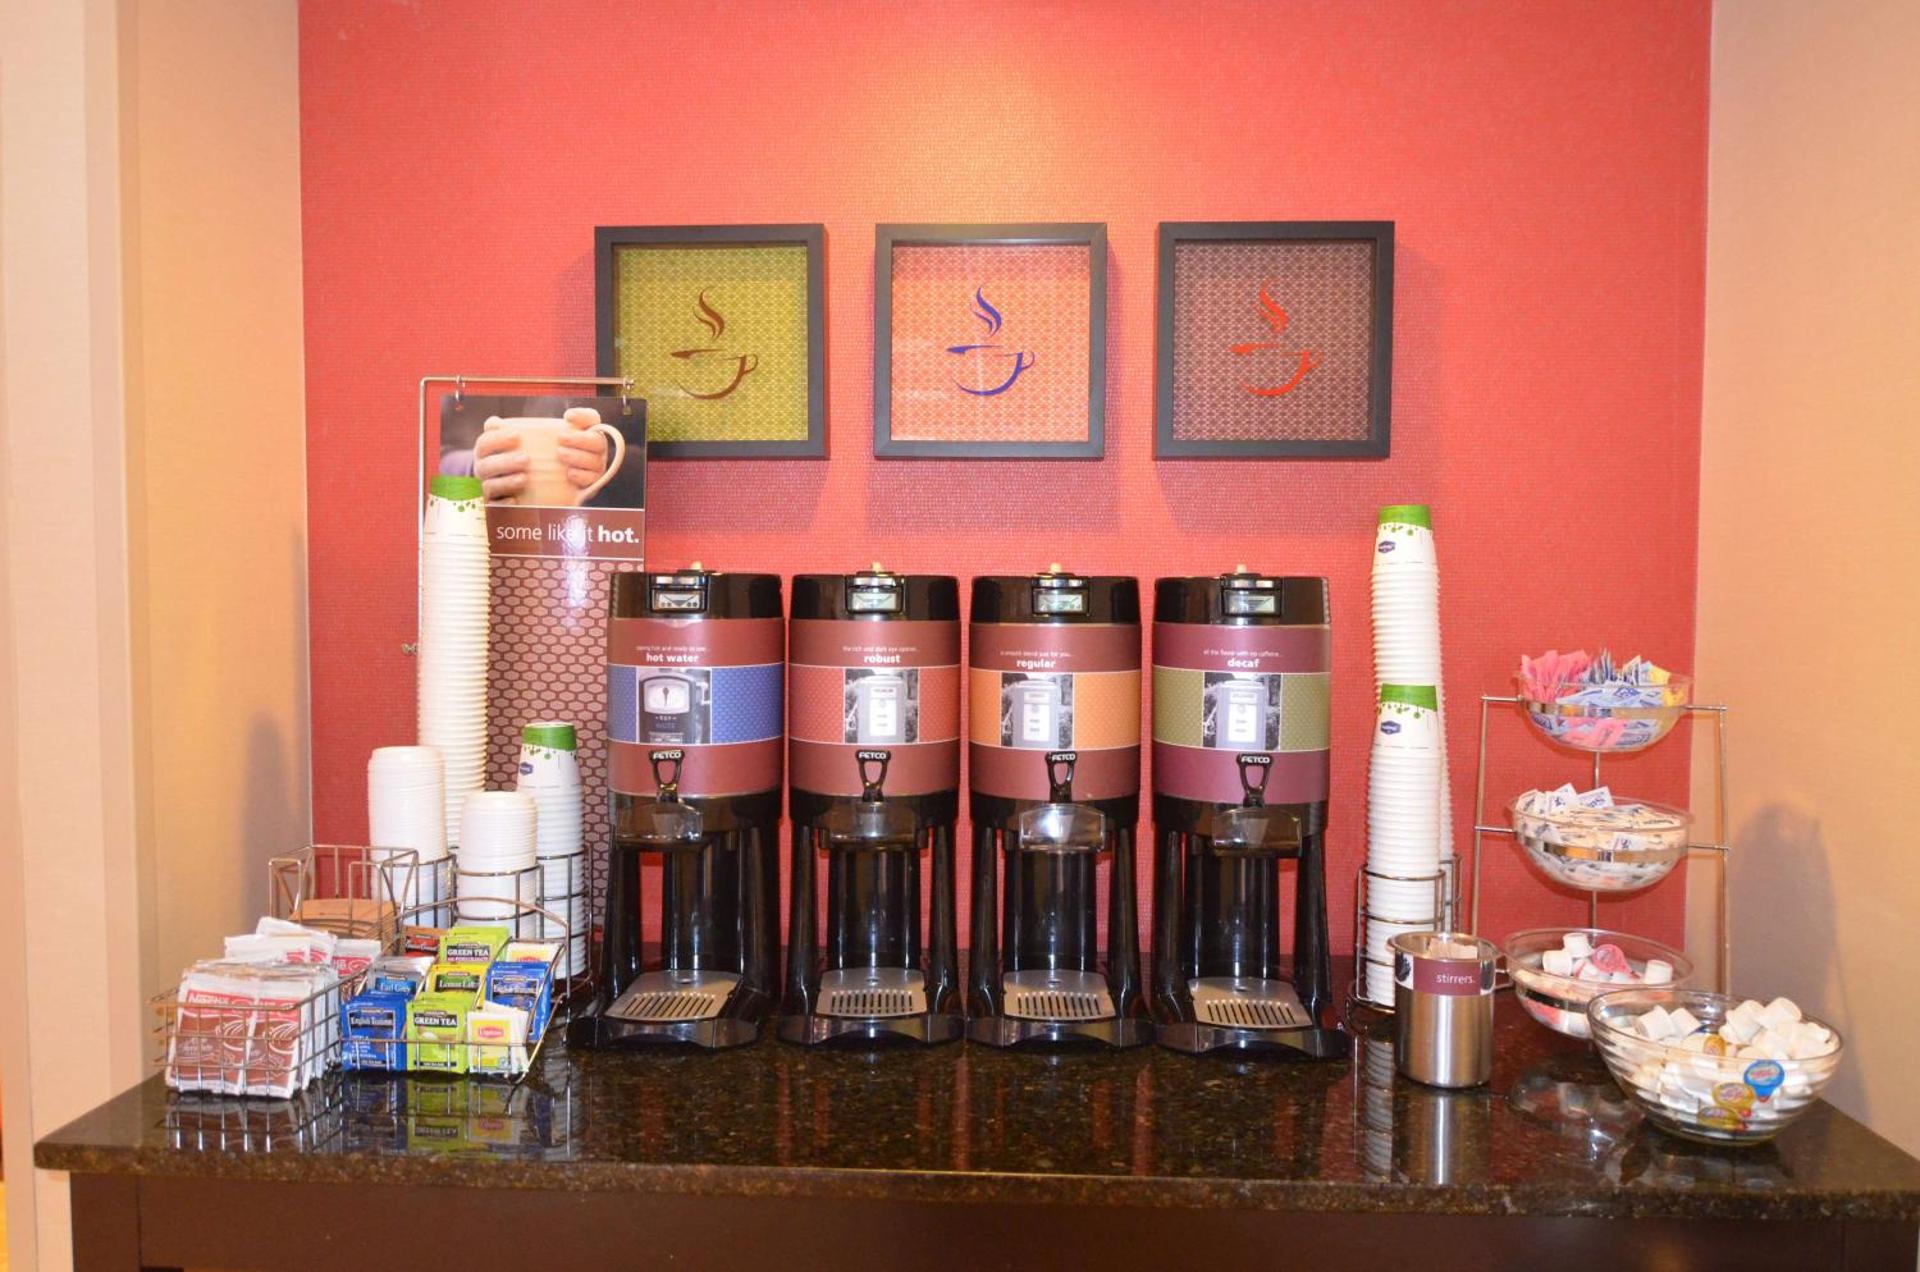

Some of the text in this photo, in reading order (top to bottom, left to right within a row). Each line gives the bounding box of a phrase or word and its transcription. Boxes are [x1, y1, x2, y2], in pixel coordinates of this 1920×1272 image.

[496, 526, 543, 541] some
[598, 525, 640, 543] hot.
[646, 652, 699, 663] hot water
[863, 653, 901, 663] robust
[1016, 658, 1056, 670] regular
[1227, 658, 1260, 668] decaf
[653, 751, 682, 760] FETCO
[858, 751, 887, 760] FETCO
[1051, 753, 1076, 762] FETCO
[1241, 755, 1270, 764] FETCO
[447, 948, 489, 957] GREEN TEA
[414, 1016, 457, 1026] GREEN TEA
